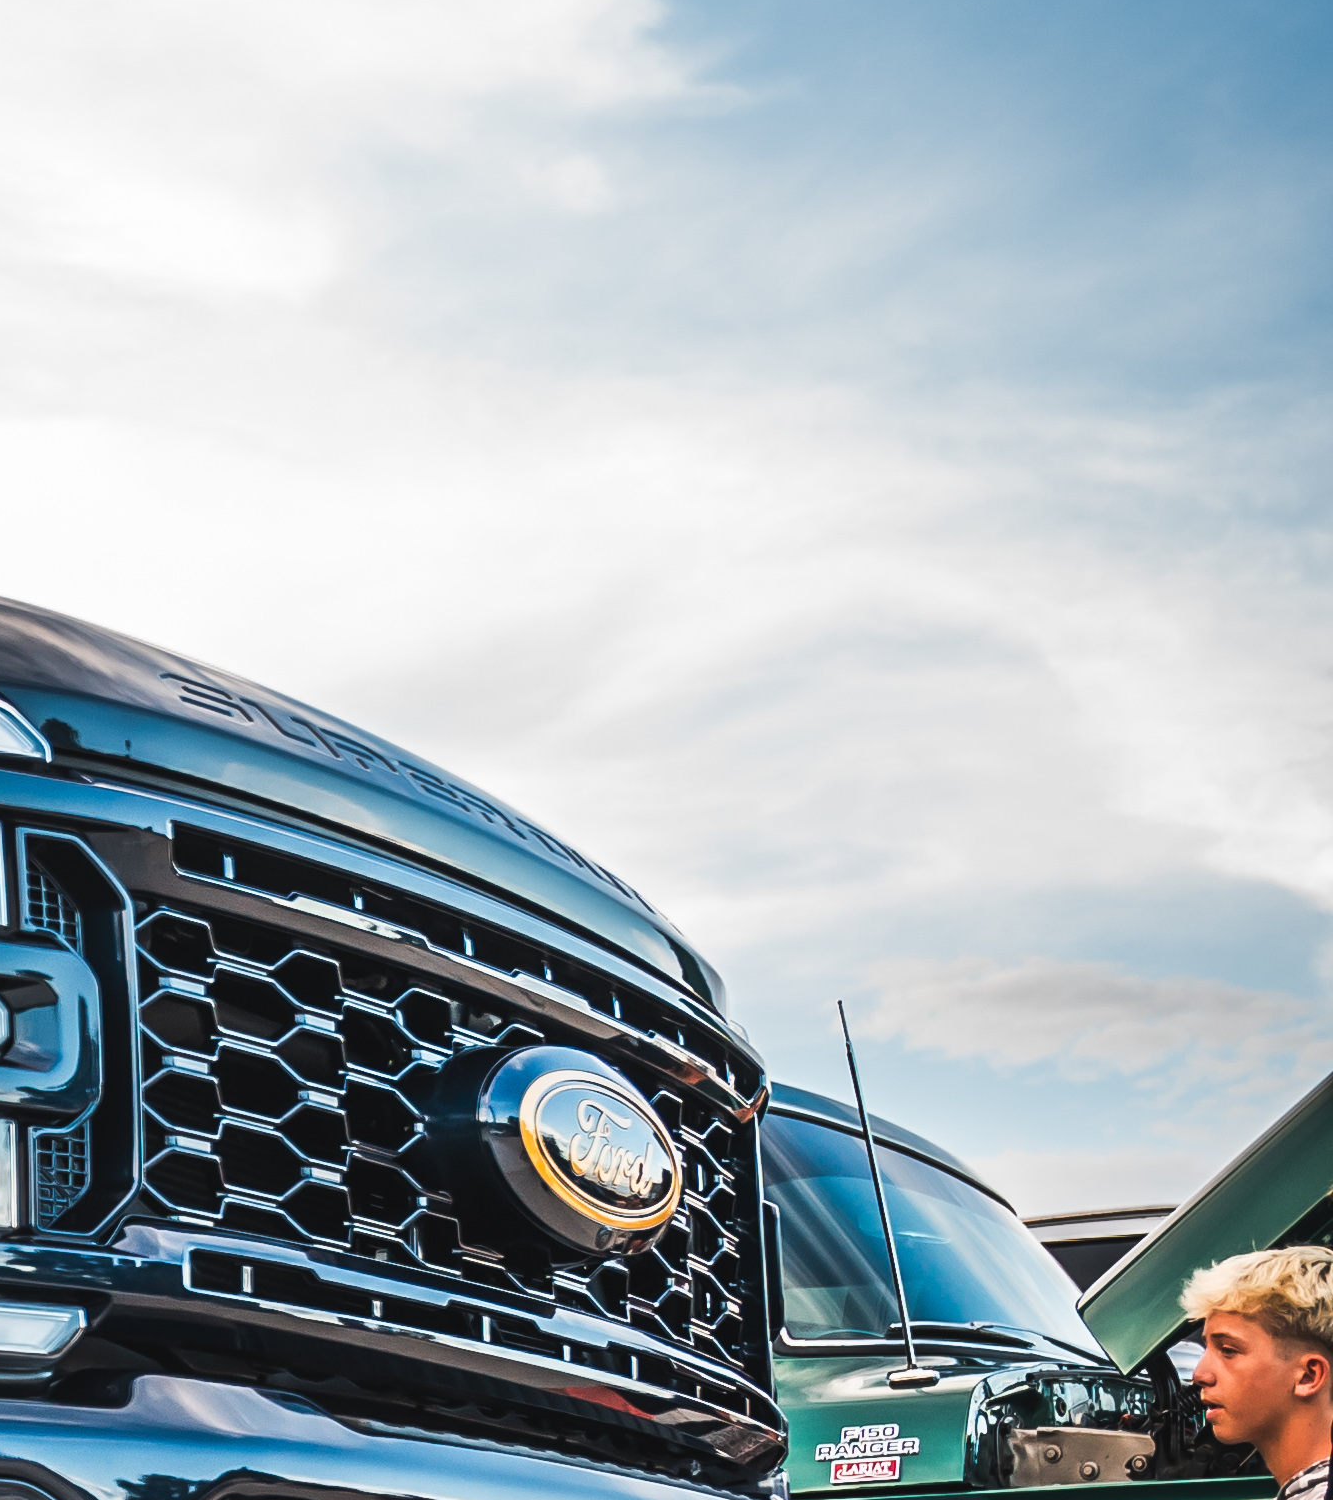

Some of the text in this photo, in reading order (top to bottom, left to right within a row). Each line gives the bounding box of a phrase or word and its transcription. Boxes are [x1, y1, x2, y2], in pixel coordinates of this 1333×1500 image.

[570, 1098, 656, 1198] Ford
[841, 1424, 900, 1443] F150
[815, 1437, 920, 1461] RANGER
[836, 1461, 894, 1478] LARIAT
